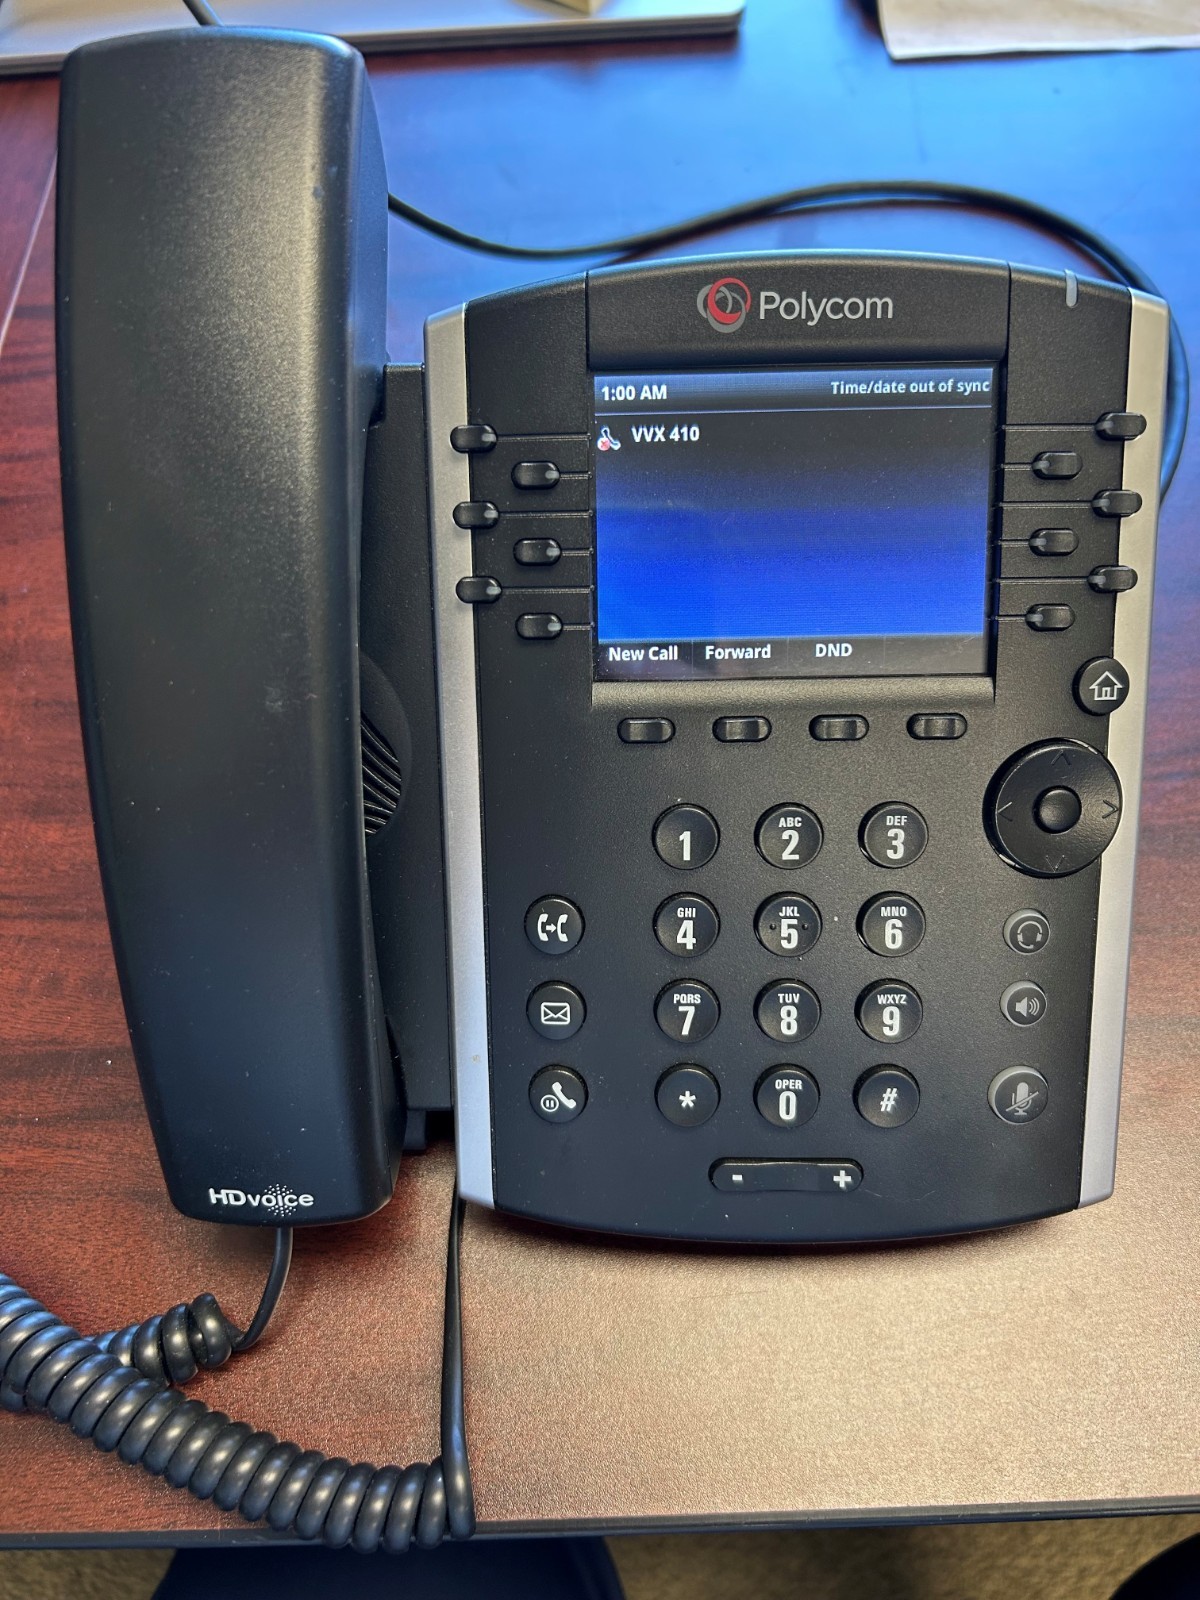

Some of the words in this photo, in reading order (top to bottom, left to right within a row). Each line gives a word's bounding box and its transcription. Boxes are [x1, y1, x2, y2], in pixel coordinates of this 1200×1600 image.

[759, 291, 893, 325] Polycom
[601, 386, 635, 401] 1:00
[640, 385, 667, 400] AM
[831, 380, 906, 395] Time/date
[909, 381, 935, 393] out
[938, 379, 953, 393] of
[957, 380, 990, 395] sync
[631, 427, 666, 442] VVX
[669, 426, 700, 442] 410
[608, 646, 644, 661] New
[648, 645, 678, 660] Call
[705, 644, 771, 660] Forward
[815, 643, 852, 657] DND
[778, 817, 802, 828] ABC
[886, 815, 907, 826] DEF
[679, 831, 691, 861] 1
[781, 829, 800, 861] 2
[886, 828, 905, 859] 3
[677, 907, 696, 918] GHI
[779, 906, 800, 917] JKL
[880, 906, 907, 917] MNO
[676, 920, 697, 950] 4
[780, 919, 799, 949] 5
[884, 918, 903, 949] 6
[673, 993, 702, 1004] PQRS
[778, 993, 800, 1004] TUV
[877, 994, 907, 1005] WXYZ
[678, 1005, 696, 1036] 7
[780, 1005, 798, 1036] 8
[882, 1006, 901, 1036] 9
[775, 1079, 802, 1090] OPER
[778, 1090, 797, 1120] 0
